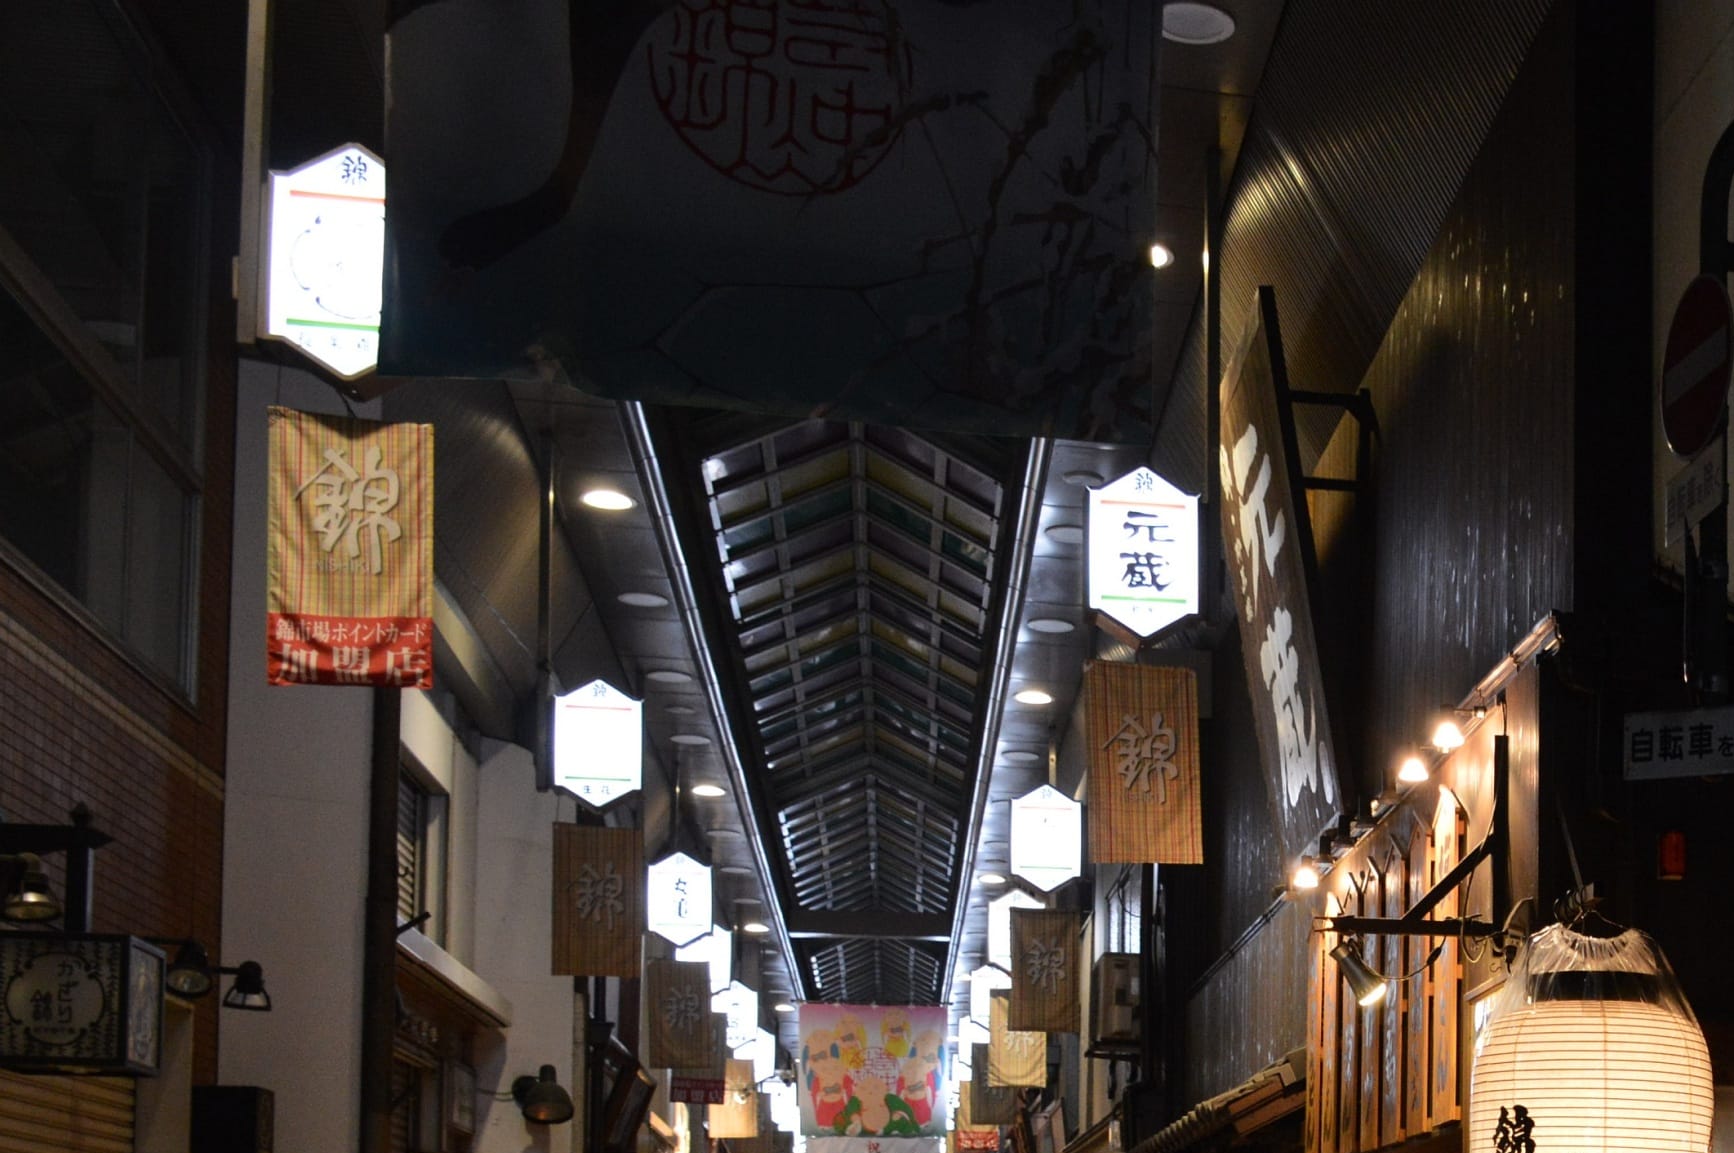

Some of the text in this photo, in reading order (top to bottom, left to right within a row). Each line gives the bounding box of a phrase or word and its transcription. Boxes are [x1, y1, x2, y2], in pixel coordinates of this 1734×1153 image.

[294, 446, 402, 576] 錦
[1119, 510, 1175, 591] 元蔵
[275, 620, 427, 645] 錦市場ポイントカード
[279, 643, 427, 687] 加盟店
[1103, 712, 1180, 805] 錦
[566, 862, 625, 932] 錦
[1025, 937, 1066, 995] 錦
